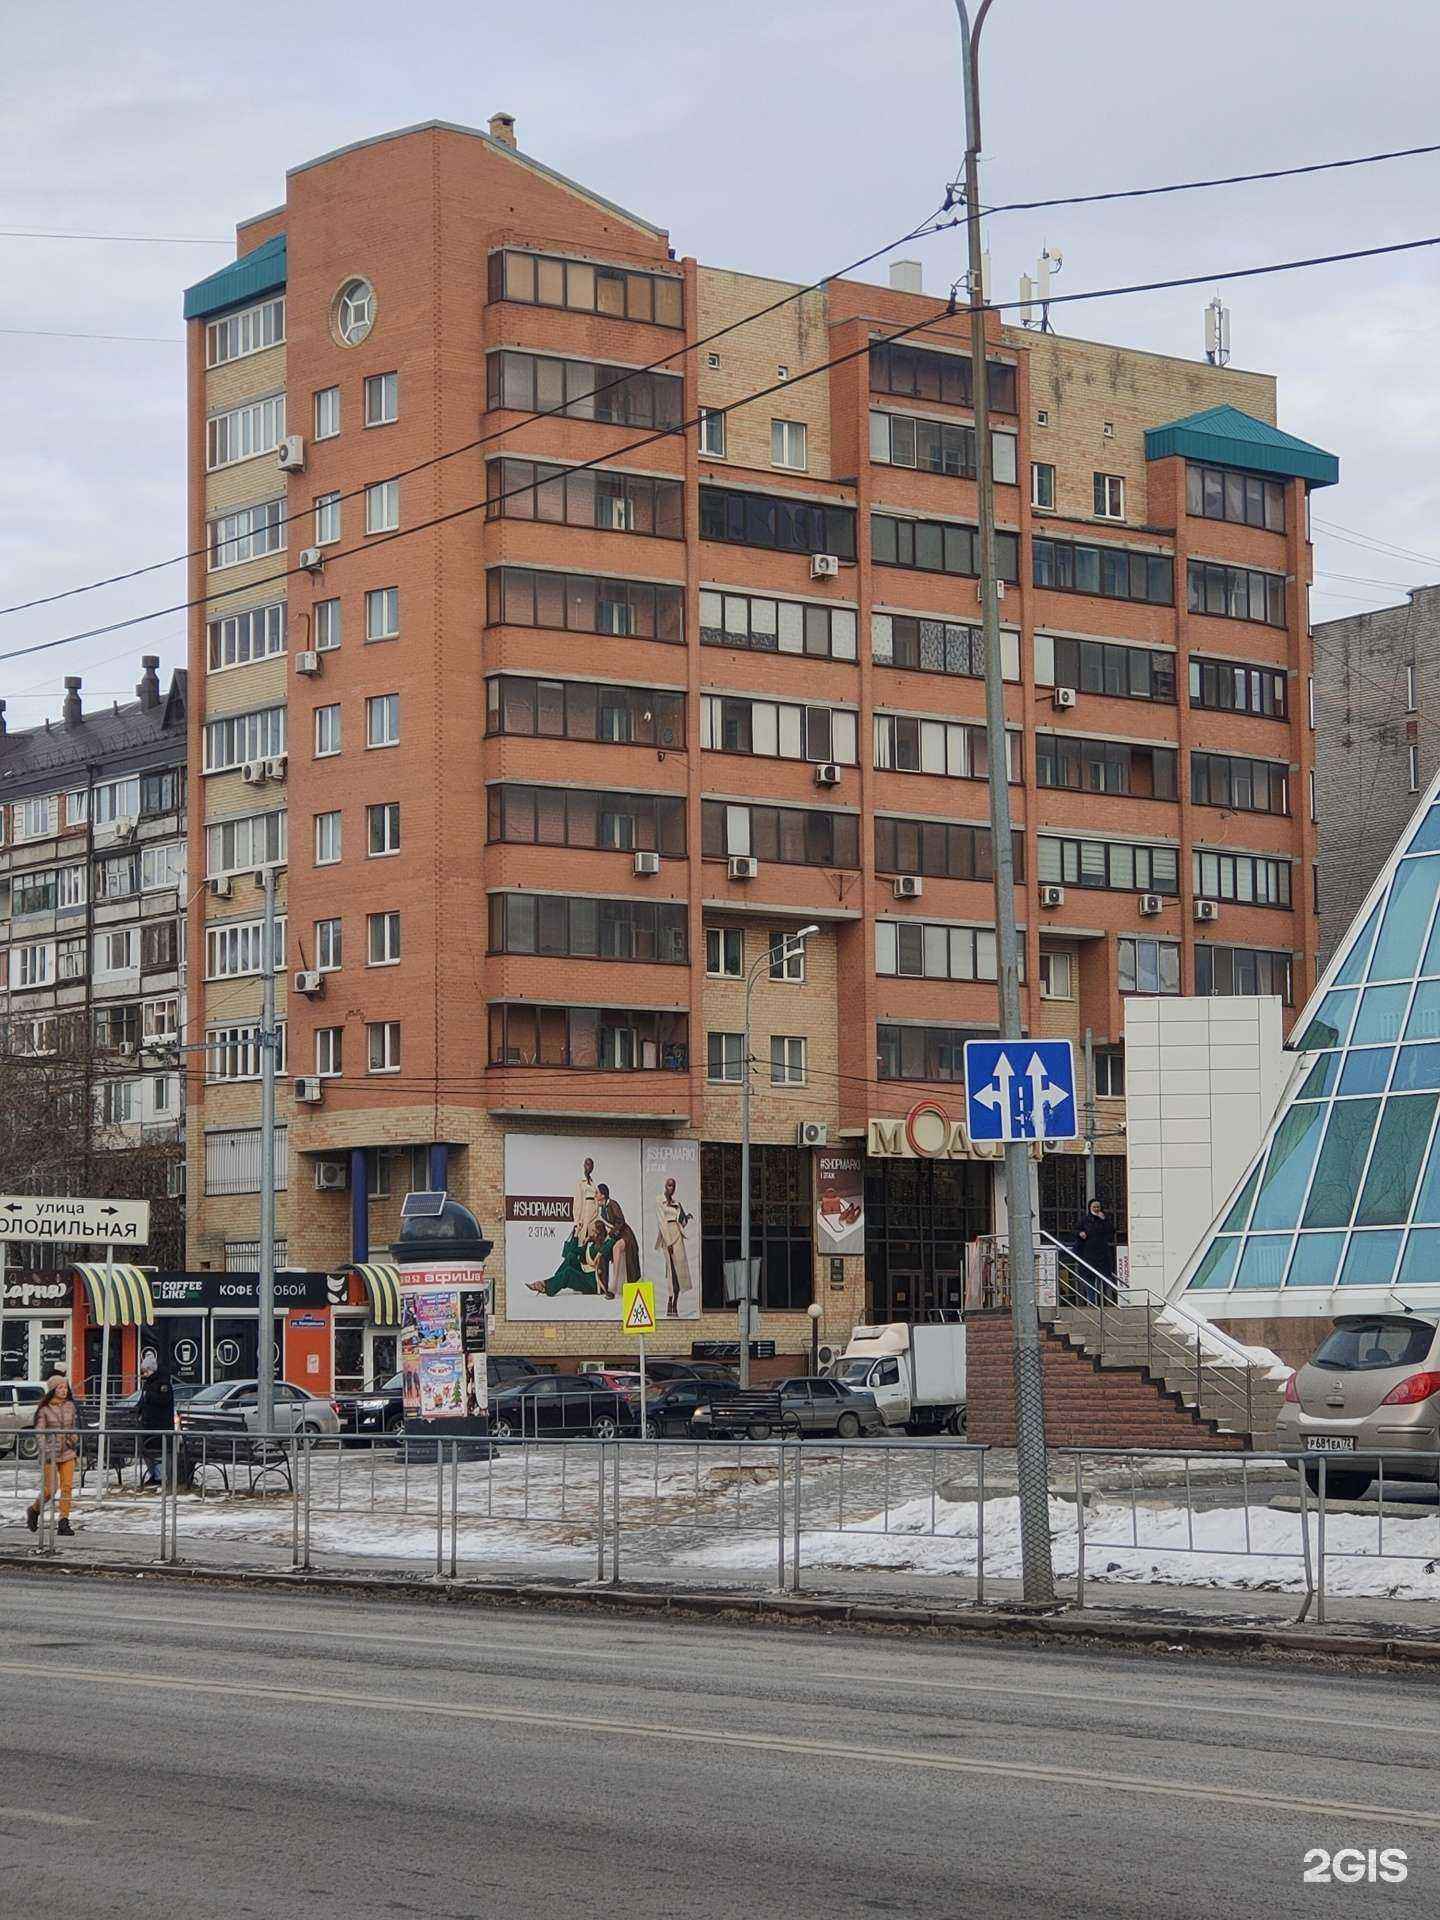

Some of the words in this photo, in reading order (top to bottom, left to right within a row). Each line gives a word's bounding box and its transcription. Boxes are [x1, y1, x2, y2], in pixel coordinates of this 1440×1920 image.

[35, 1203, 85, 1216] улица
[513, 1201, 571, 1217] #SHOPMARKI
[162, 1281, 203, 1291] COFFEE
[219, 1284, 253, 1296] КОФЕ
[272, 1283, 306, 1296] ОБОЙ
[162, 1290, 186, 1299] LIKE
